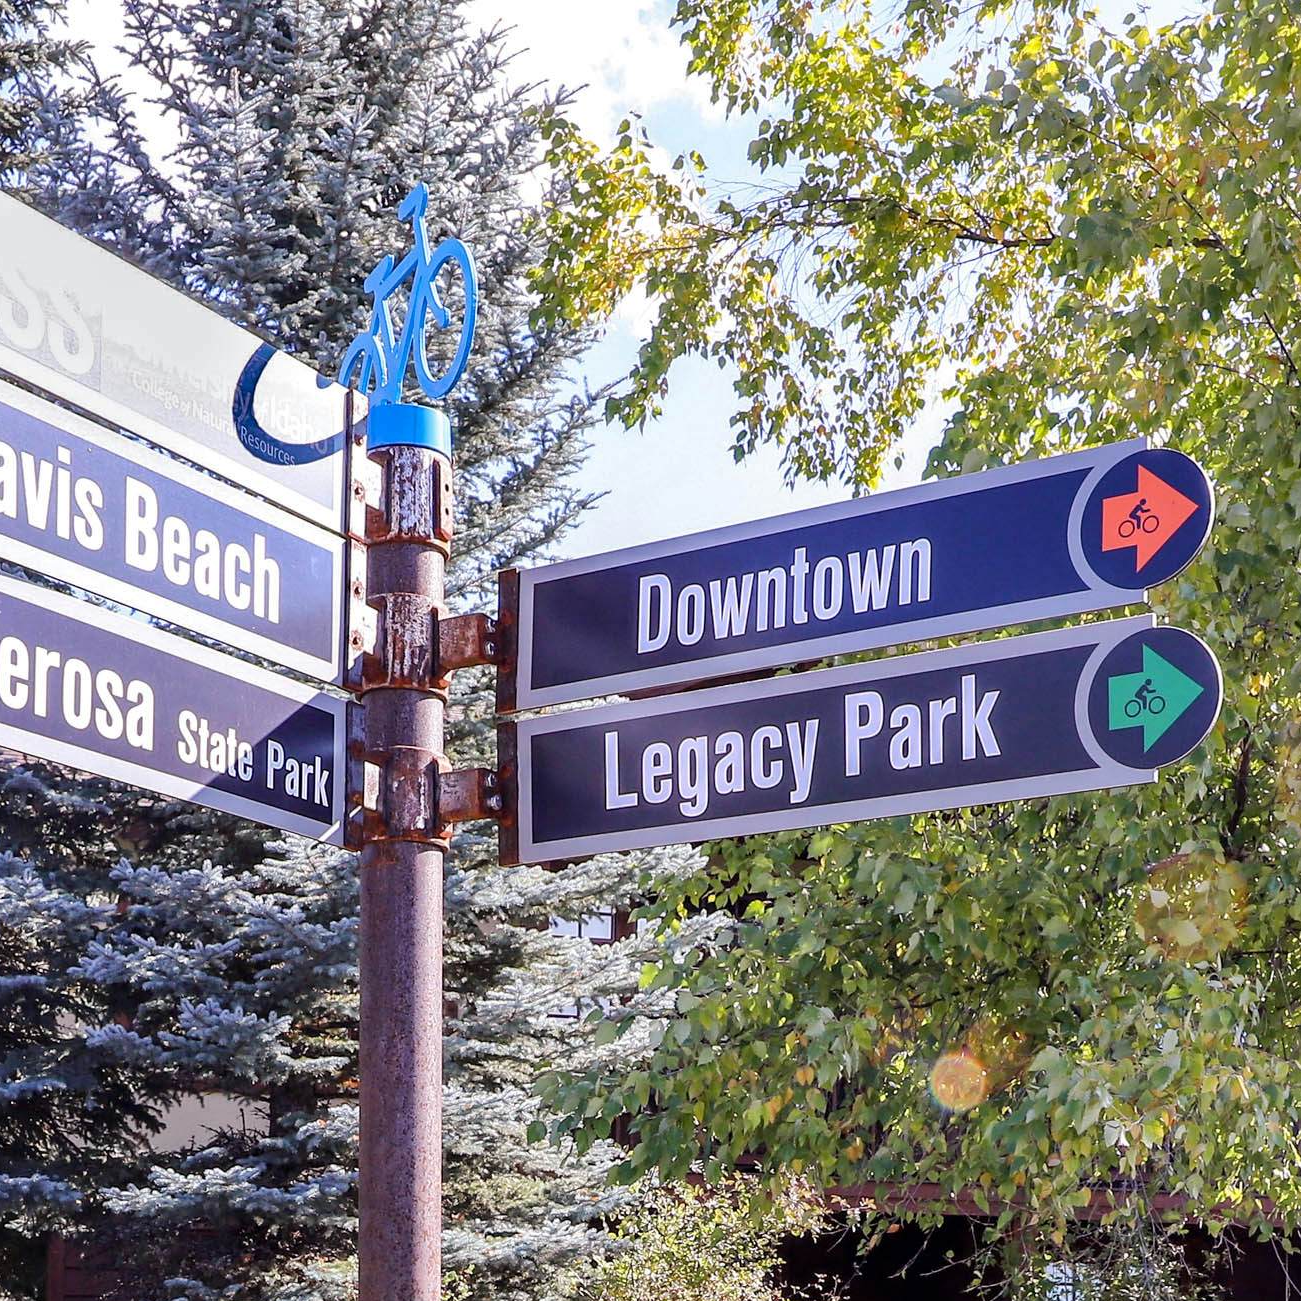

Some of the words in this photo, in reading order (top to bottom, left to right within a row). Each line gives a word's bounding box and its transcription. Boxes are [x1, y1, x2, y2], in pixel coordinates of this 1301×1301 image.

[131, 371, 180, 410] College
[240, 425, 296, 467] Resources
[124, 474, 281, 625] Beach
[636, 536, 933, 655] Downtown
[177, 708, 253, 782] State
[266, 739, 329, 808] Park
[604, 717, 819, 818] Legacy
[844, 674, 1002, 778] Park
